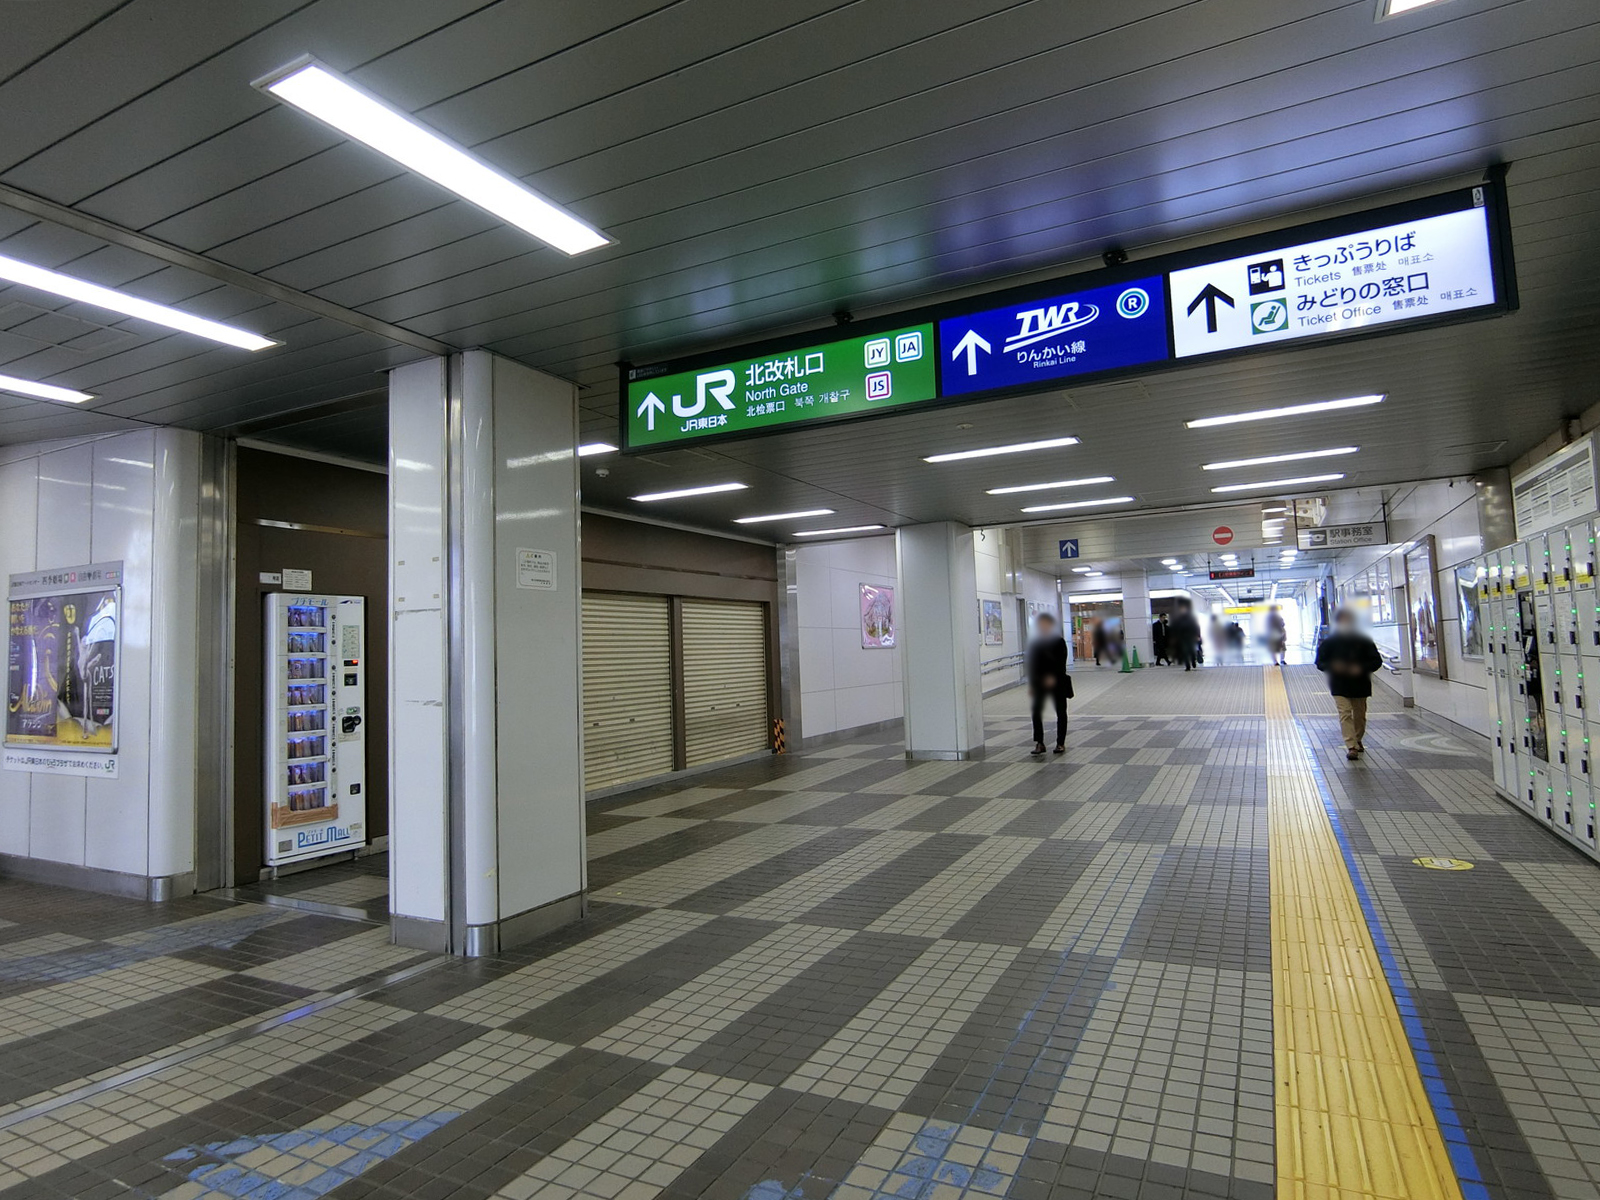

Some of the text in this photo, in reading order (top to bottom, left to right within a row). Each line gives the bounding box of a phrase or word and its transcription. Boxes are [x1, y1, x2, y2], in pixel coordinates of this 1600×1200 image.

[1293, 231, 1417, 272] きっぷうりば
[1398, 253, 1434, 266] 매표소
[1352, 261, 1387, 276] 售票处
[1294, 272, 1341, 287] Tickets
[1296, 272, 1430, 311] みどりの窓口
[1440, 287, 1478, 301] 매표소
[1127, 297, 1138, 309] R
[1392, 295, 1428, 310] 售票处
[1009, 302, 1083, 340] TWR
[1298, 305, 1382, 327] Ticket Office
[870, 341, 917, 360] JY JA
[1017, 340, 1086, 363] りんかい線
[745, 353, 824, 386] 北改札口
[1033, 355, 1076, 368] Rinkai Line
[672, 369, 736, 418] JR
[745, 382, 809, 402] North Gate
[872, 380, 885, 392] JS
[794, 389, 850, 408] 북쪽 개찰구
[746, 400, 785, 417] 北检票口
[680, 414, 728, 432] JR東日本
[1330, 526, 1373, 538] 駅事務室
[93, 665, 115, 686] CATS
[104, 759, 116, 769] JR
